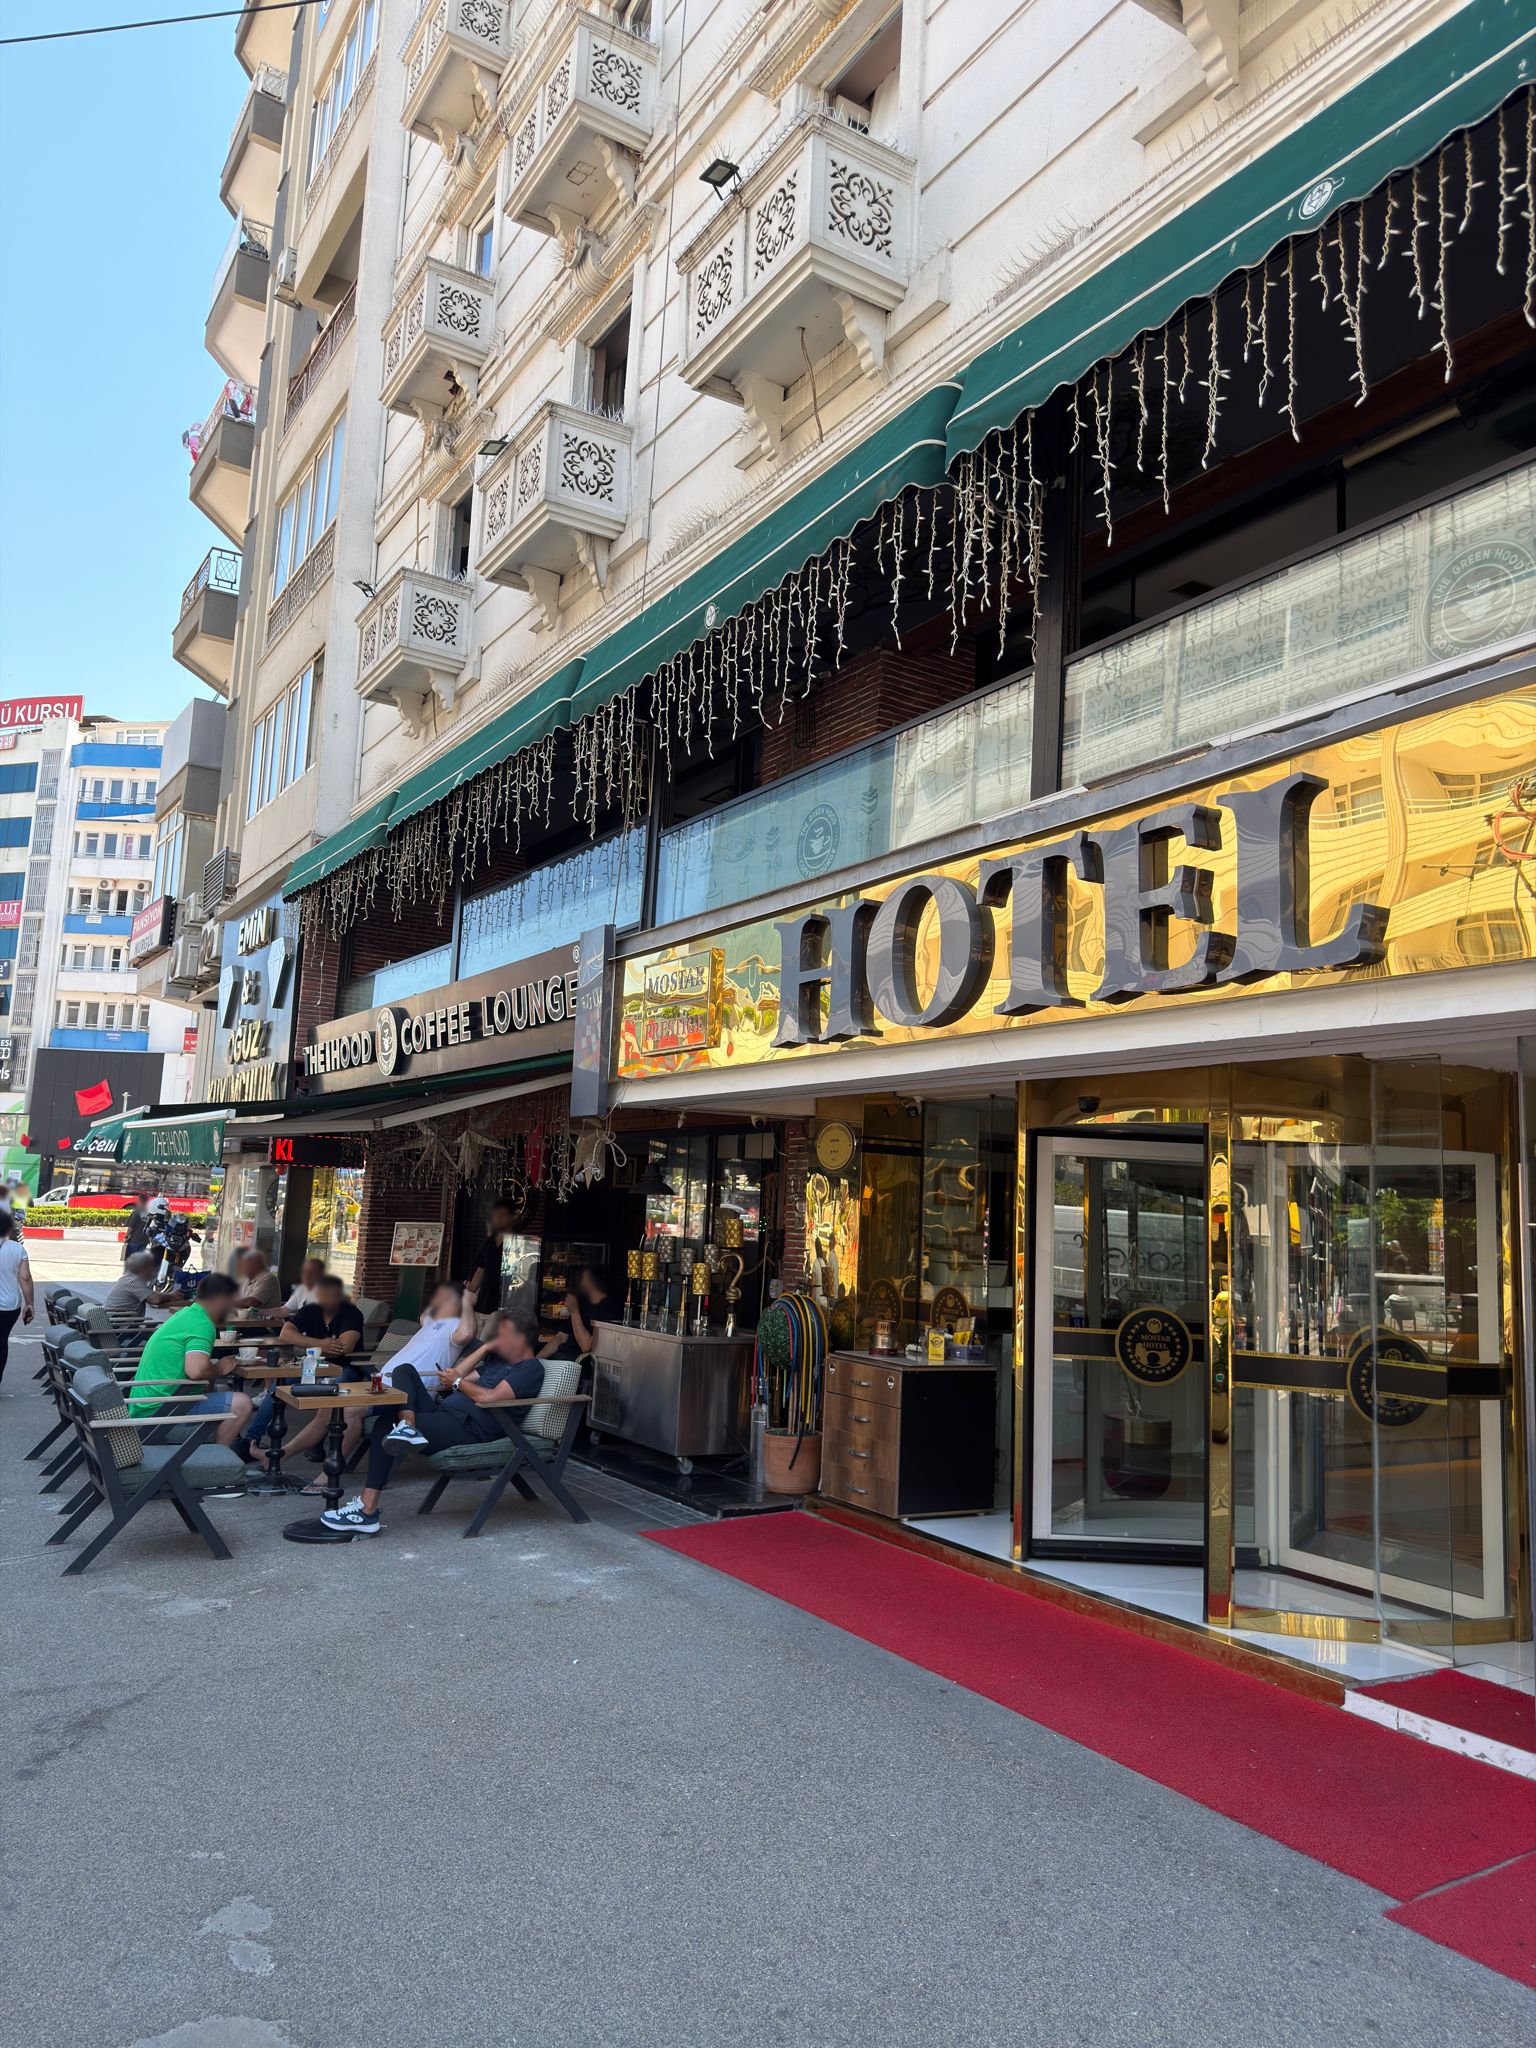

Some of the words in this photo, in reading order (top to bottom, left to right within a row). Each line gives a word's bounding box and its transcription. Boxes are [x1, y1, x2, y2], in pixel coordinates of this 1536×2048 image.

[1432, 572, 1451, 601] THE
[1452, 549, 1492, 577] GREEN
[1494, 548, 1525, 572] HOOD
[15, 702, 78, 723] KURSU
[770, 772, 1391, 1049] HOTEL
[238, 906, 270, 956] EMİN
[647, 964, 706, 1000] MOSTAR
[400, 1001, 471, 1056] COFFEE
[482, 970, 578, 1036] LOUNGE
[645, 1014, 704, 1042] PRESTIGE
[1140, 1333, 1172, 1343] MOSTAR
[1142, 1341, 1169, 1350] HOTEL
